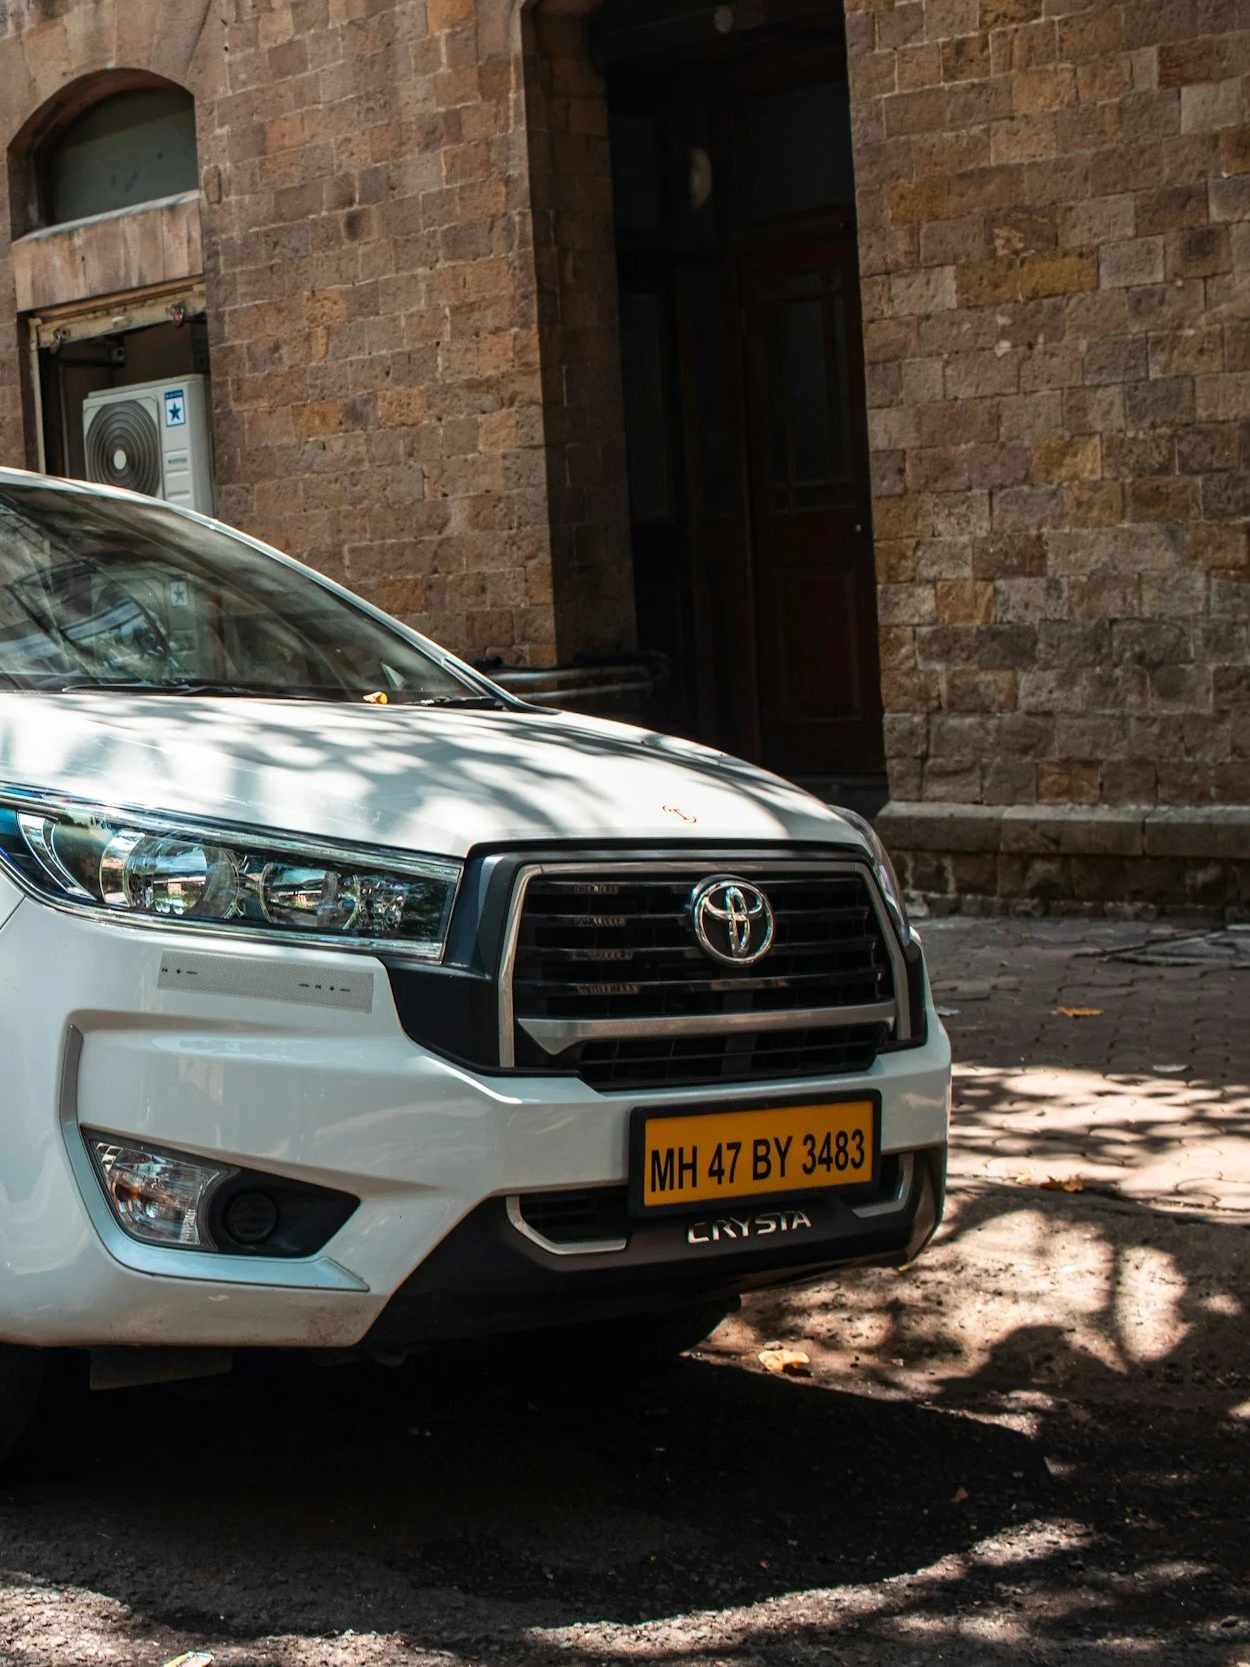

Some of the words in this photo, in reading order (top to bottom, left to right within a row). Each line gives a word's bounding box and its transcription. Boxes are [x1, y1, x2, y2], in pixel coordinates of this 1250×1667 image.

[650, 1145, 698, 1193] MH
[708, 1141, 742, 1185] 47
[752, 1135, 793, 1181] BY
[801, 1128, 865, 1175] 3483
[687, 1209, 813, 1244] CRYSTA
